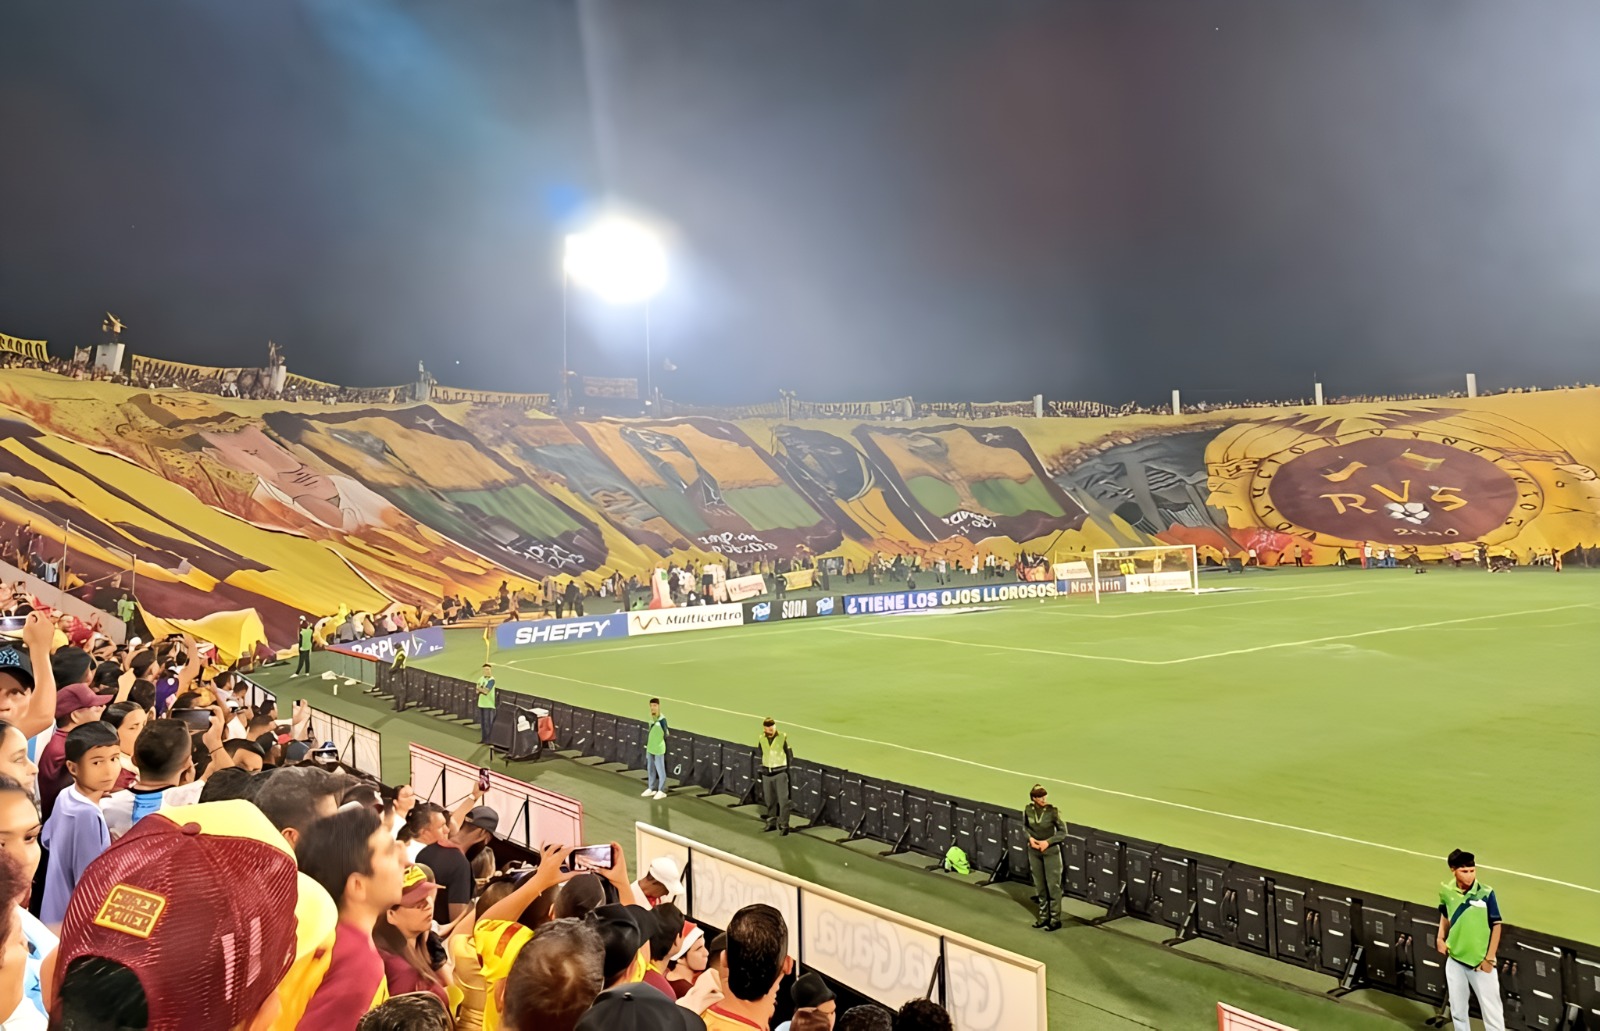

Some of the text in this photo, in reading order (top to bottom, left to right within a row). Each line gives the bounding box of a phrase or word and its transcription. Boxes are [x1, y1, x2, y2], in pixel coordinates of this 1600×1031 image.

[781, 599, 808, 619] SODA
[847, 592, 905, 614] ¿TIENE
[907, 591, 938, 609] LOS
[941, 588, 981, 606] OJOS
[666, 610, 742, 625] Multicentro
[514, 620, 609, 645] SHEFFY
